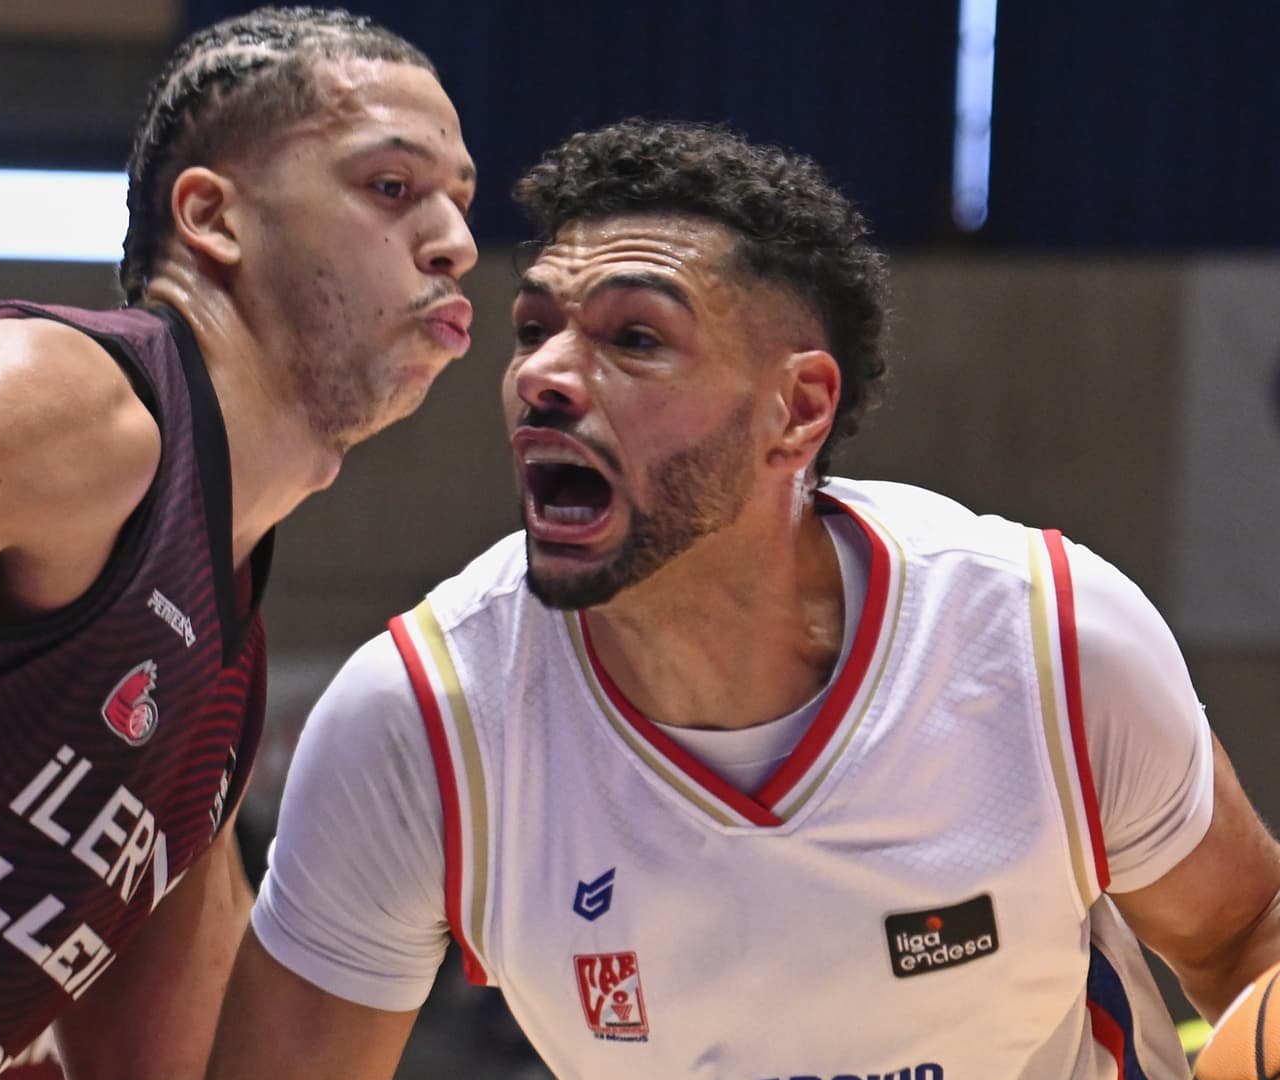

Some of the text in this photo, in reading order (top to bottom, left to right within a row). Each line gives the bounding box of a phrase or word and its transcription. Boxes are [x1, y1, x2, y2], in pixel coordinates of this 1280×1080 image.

[9, 744, 190, 915] iLERN
[897, 931, 940, 953] liga
[901, 934, 992, 971] endesa
